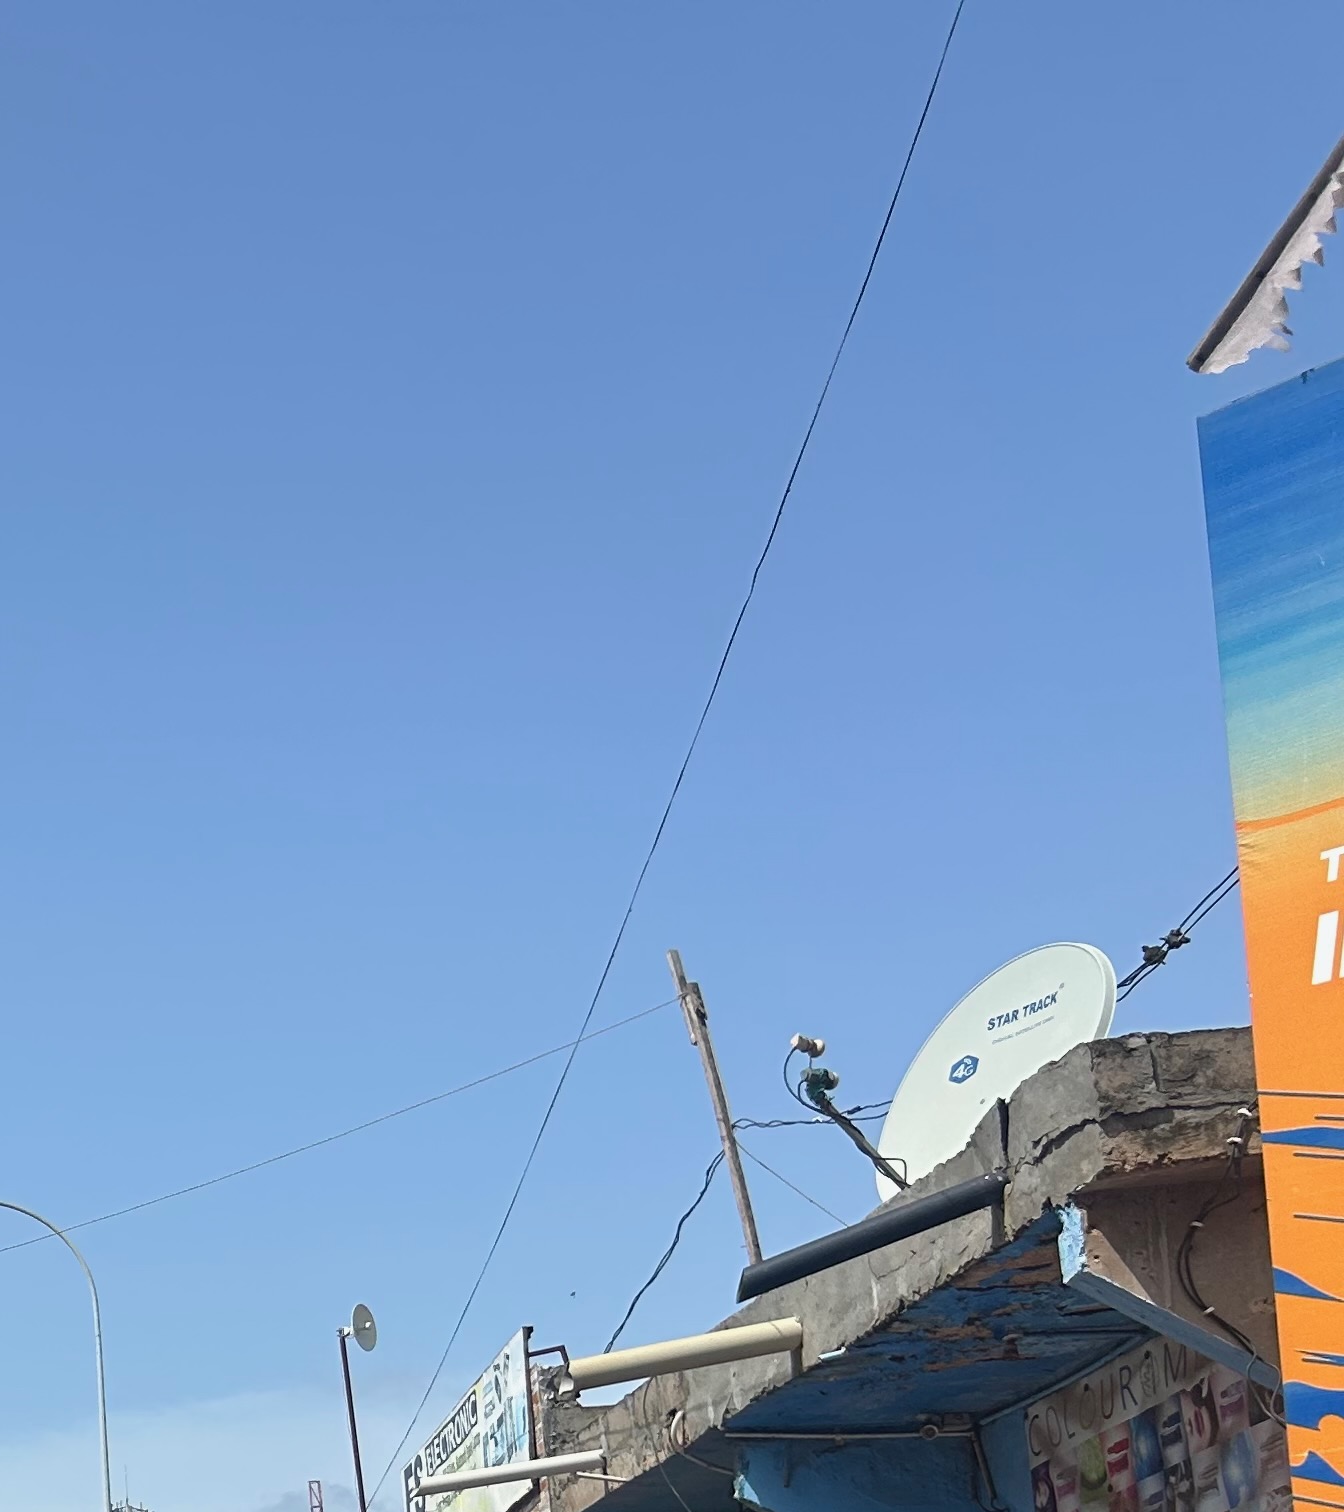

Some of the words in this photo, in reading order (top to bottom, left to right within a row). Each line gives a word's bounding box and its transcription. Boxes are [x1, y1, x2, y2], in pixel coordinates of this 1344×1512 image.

[987, 1009, 1019, 1031] STAR
[1022, 991, 1058, 1017] TRACK
[952, 1063, 974, 1079] 4G
[426, 1392, 477, 1475] ELECTRONIC
